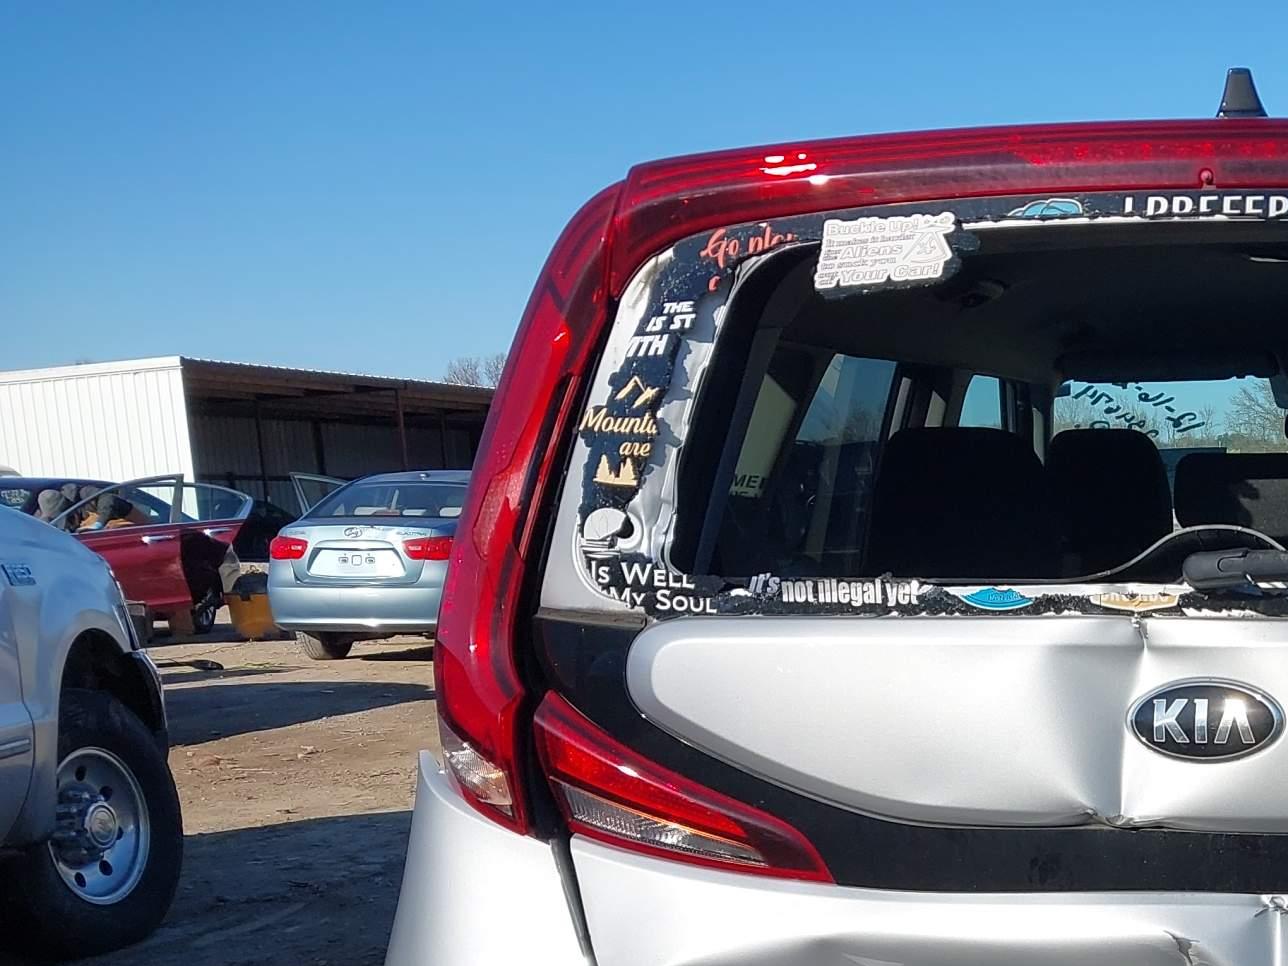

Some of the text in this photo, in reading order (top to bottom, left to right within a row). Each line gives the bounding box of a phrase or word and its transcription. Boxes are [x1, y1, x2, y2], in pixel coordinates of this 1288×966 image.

[827, 218, 919, 236] Buckle Up!
[840, 245, 903, 260] Aliens
[839, 263, 940, 283] Your Car!
[662, 301, 696, 314] THE
[619, 441, 651, 457] are
[780, 579, 815, 603] not
[1153, 698, 1256, 745] KIA
